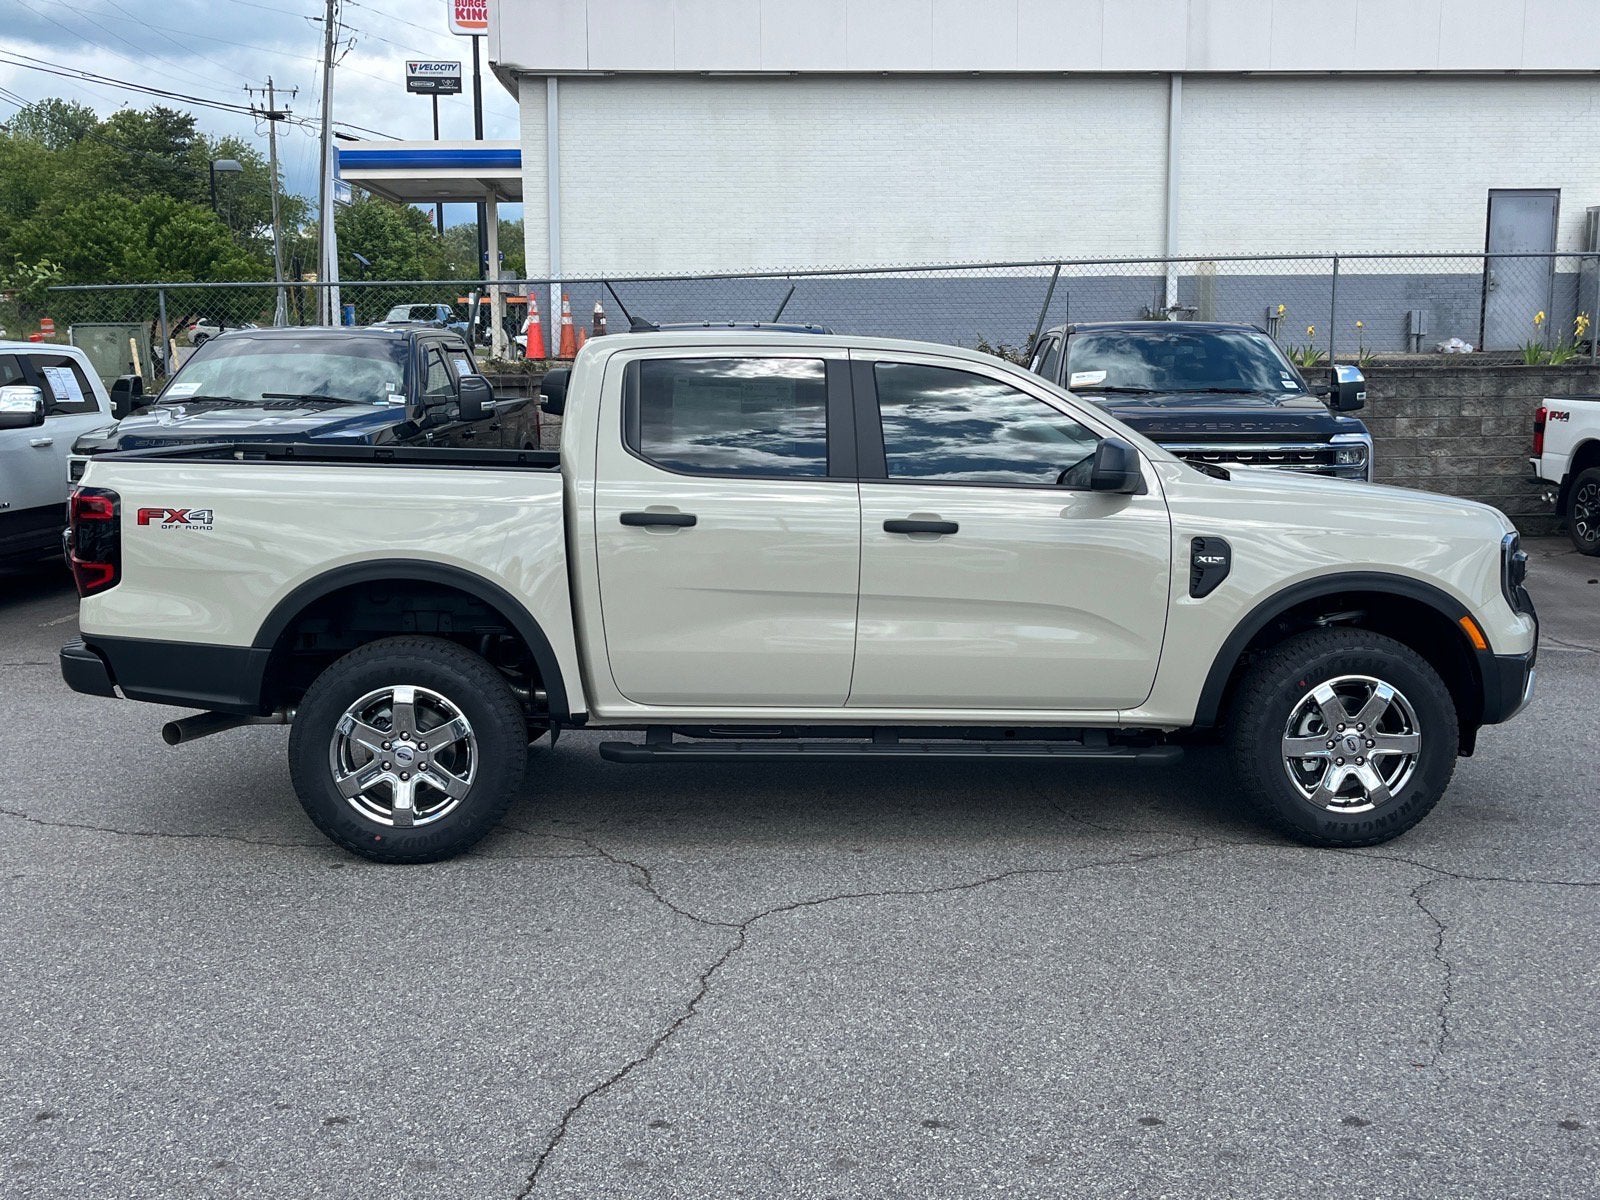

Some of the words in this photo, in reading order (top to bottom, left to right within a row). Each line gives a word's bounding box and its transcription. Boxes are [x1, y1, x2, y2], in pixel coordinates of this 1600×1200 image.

[455, 0, 487, 8] BURGE
[1549, 411, 1570, 421] FX4
[137, 508, 214, 525] FX4
